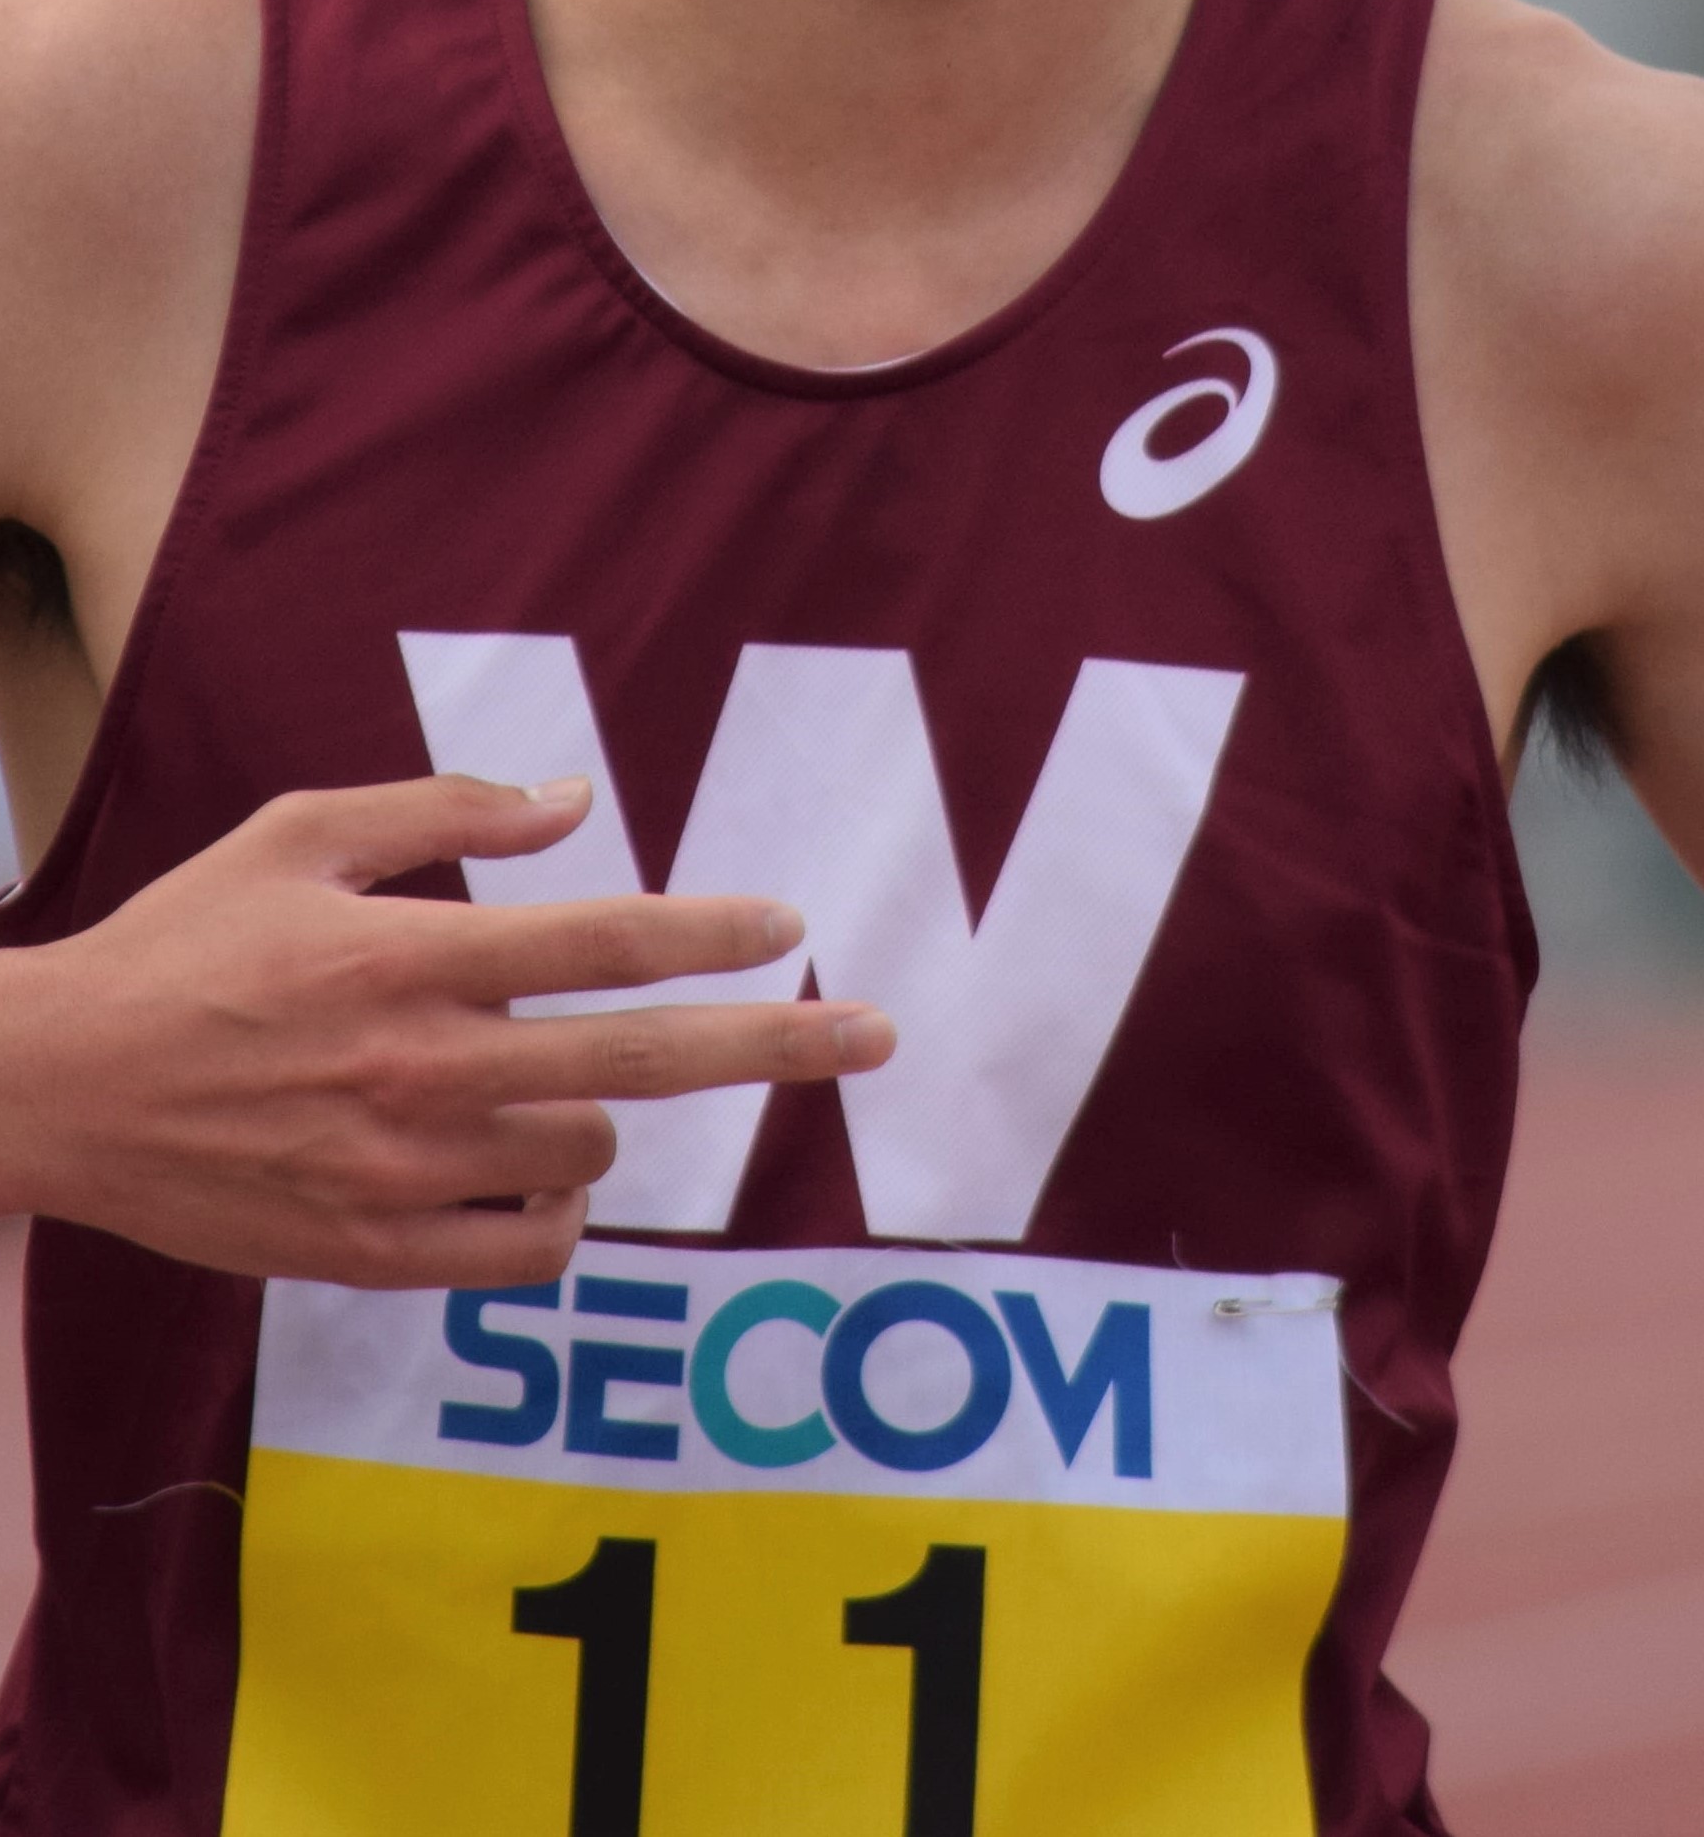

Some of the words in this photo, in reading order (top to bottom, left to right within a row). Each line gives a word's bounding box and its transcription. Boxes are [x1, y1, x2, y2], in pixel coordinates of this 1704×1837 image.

[398, 630, 1247, 1243] W
[437, 1274, 1152, 1480] SECOM
[511, 1535, 988, 1837] 11
